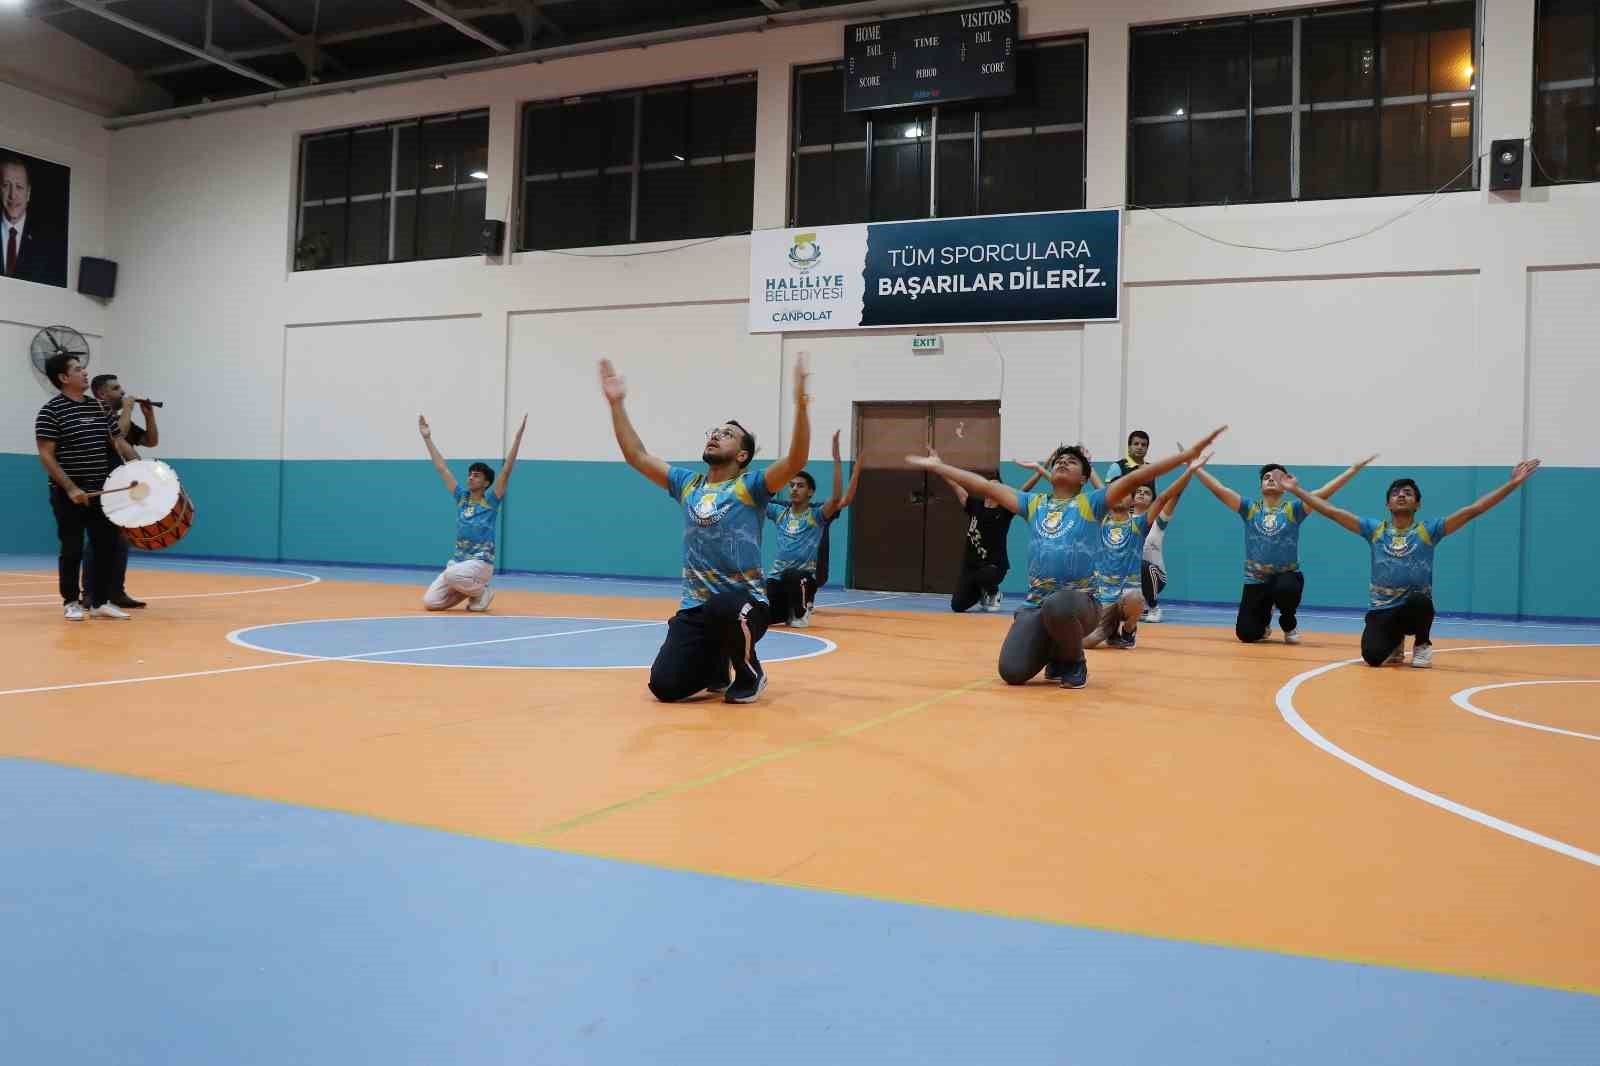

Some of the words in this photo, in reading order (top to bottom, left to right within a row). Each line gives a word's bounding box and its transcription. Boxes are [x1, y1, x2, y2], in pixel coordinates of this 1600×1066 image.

[960, 9, 1011, 27] VISITORS
[856, 25, 880, 41] HOME
[914, 37, 939, 48] TIME
[981, 61, 1004, 74] SCORE
[859, 76, 880, 87] SCORE
[888, 246, 934, 267] TÜM
[941, 240, 1091, 264] SPORCULARA
[878, 272, 1004, 300] BAŞARILAR
[1009, 264, 1107, 290] DİLERİZ.
[772, 310, 832, 322] CANPOLAT
[912, 338, 937, 347] EXIT
